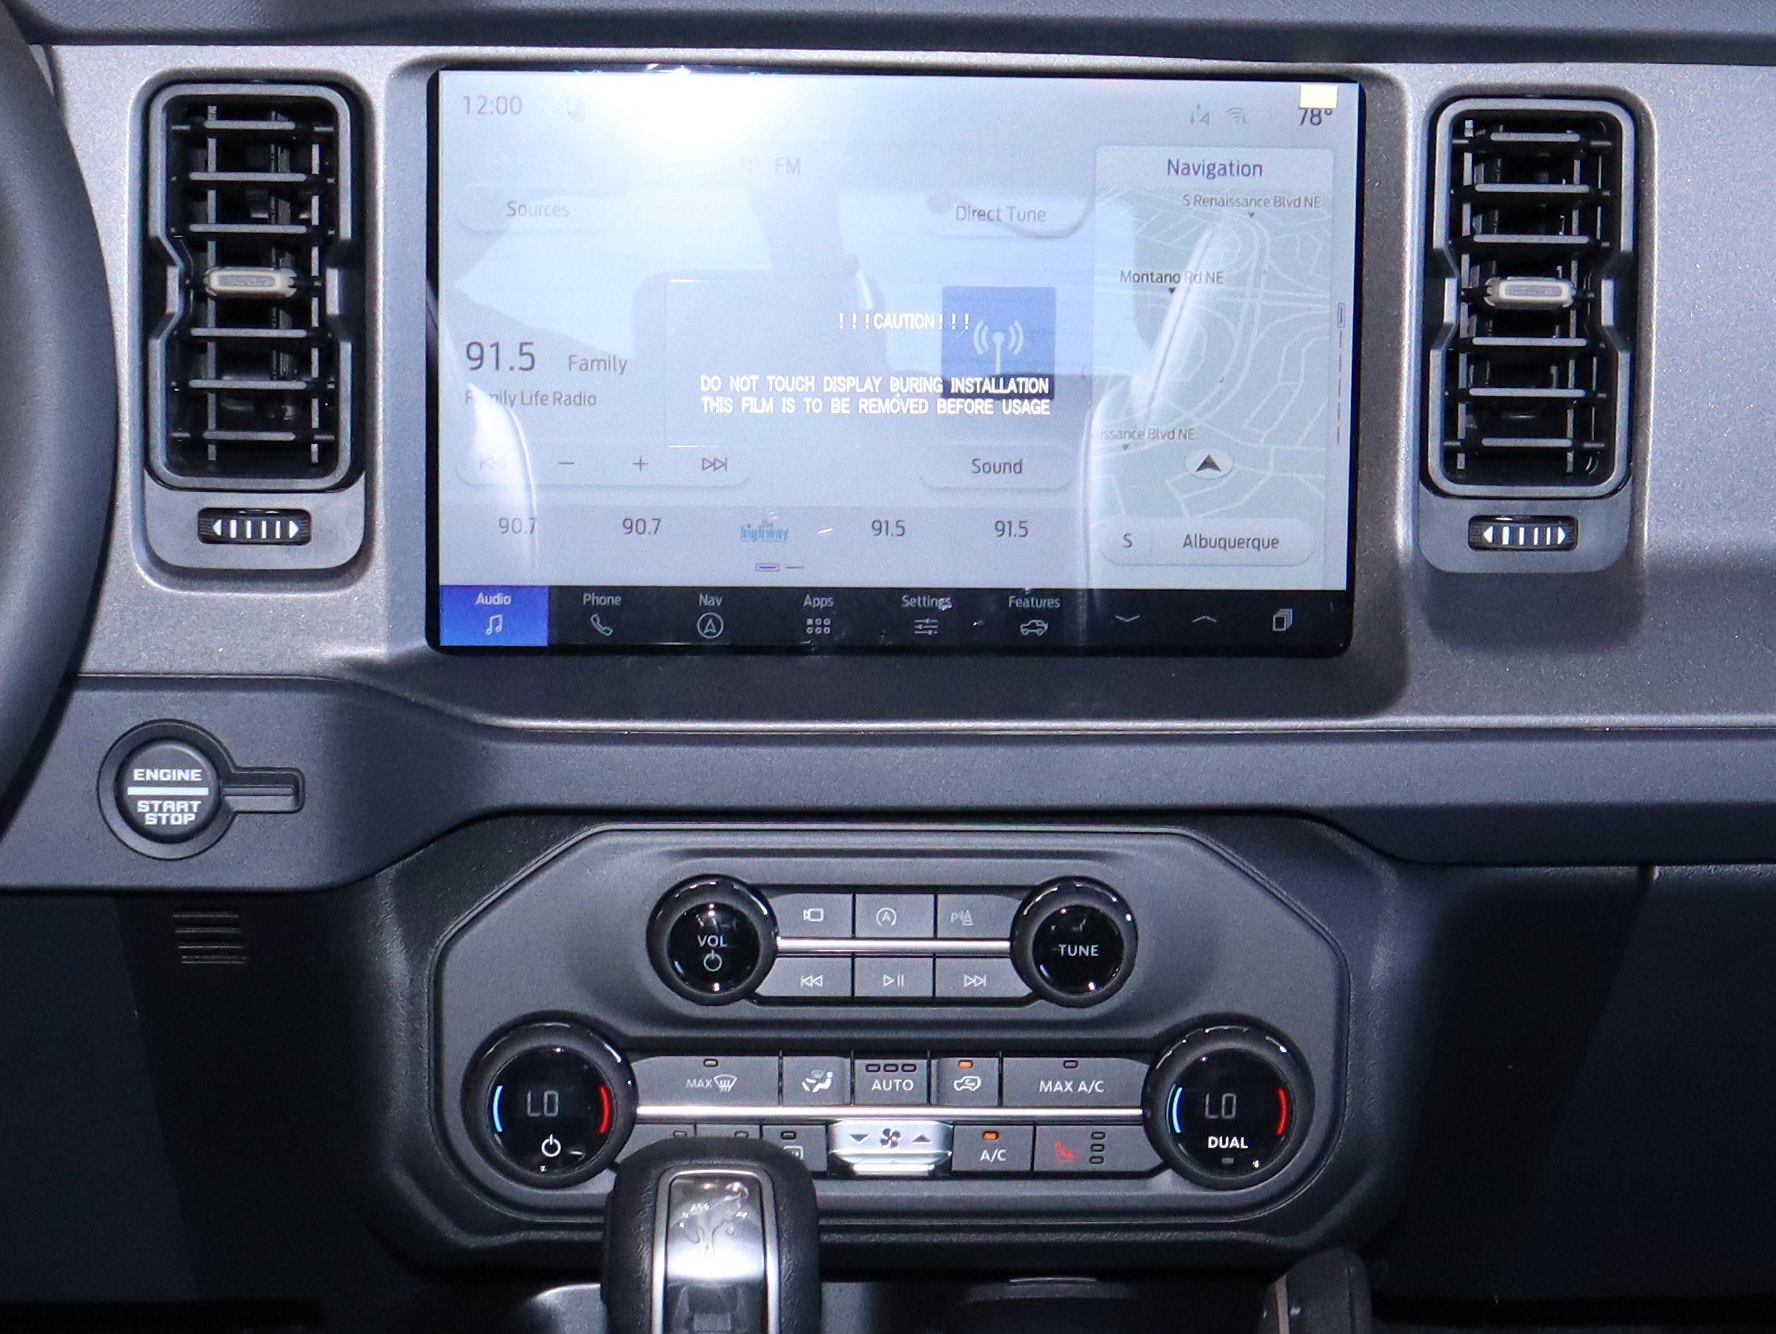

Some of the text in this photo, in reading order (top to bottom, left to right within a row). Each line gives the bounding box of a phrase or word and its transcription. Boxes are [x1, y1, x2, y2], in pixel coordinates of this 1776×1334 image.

[462, 95, 522, 116] 12:00
[775, 158, 802, 175] FM
[1166, 158, 1263, 180] Navigation
[506, 199, 570, 218] Sources
[1193, 194, 1271, 208] Renaissance
[1273, 195, 1301, 208] Blvd
[1304, 196, 1322, 208] NE
[955, 205, 1047, 222] Direct Tune
[1119, 271, 1225, 284] Montano Rd NE
[874, 314, 935, 330] CAUTION
[465, 341, 536, 372] 91.5
[568, 355, 629, 375] Family
[700, 375, 1049, 394] DO NOT TOUCH DISPLAY DURING INSTALLATION
[520, 390, 549, 406] Life
[553, 390, 597, 407] Radio
[701, 396, 1050, 415] THIS FILM IS TO BE REMOVED BEFORE USAGE
[1147, 428, 1175, 441] Blvd
[1178, 428, 1196, 441] NE
[971, 458, 1023, 475] Sound
[498, 517, 537, 536] 90.7
[622, 517, 662, 536] 90.7
[870, 520, 906, 538] 91.5
[993, 521, 1029, 538] 91.5
[1123, 533, 1133, 549] S
[1182, 533, 1280, 552] Albuquerque
[475, 592, 511, 607] Audio
[583, 593, 622, 607] Phone
[699, 594, 723, 607] Nav
[803, 594, 834, 610] Apps
[901, 594, 952, 612] Settings
[1008, 594, 1060, 609] Features
[133, 768, 203, 781] ENGINE
[137, 800, 201, 813] START
[144, 812, 196, 825] STOP
[697, 935, 727, 947] VOL
[1058, 944, 1099, 957] TUNE
[686, 1078, 713, 1089] MAX
[871, 1079, 914, 1092] AUTO
[1039, 1079, 1105, 1094] MAX A/C
[527, 1090, 560, 1117] LO
[1204, 1092, 1237, 1119] LO
[1207, 1137, 1249, 1149] DUAL
[980, 1148, 1007, 1162] A/C
